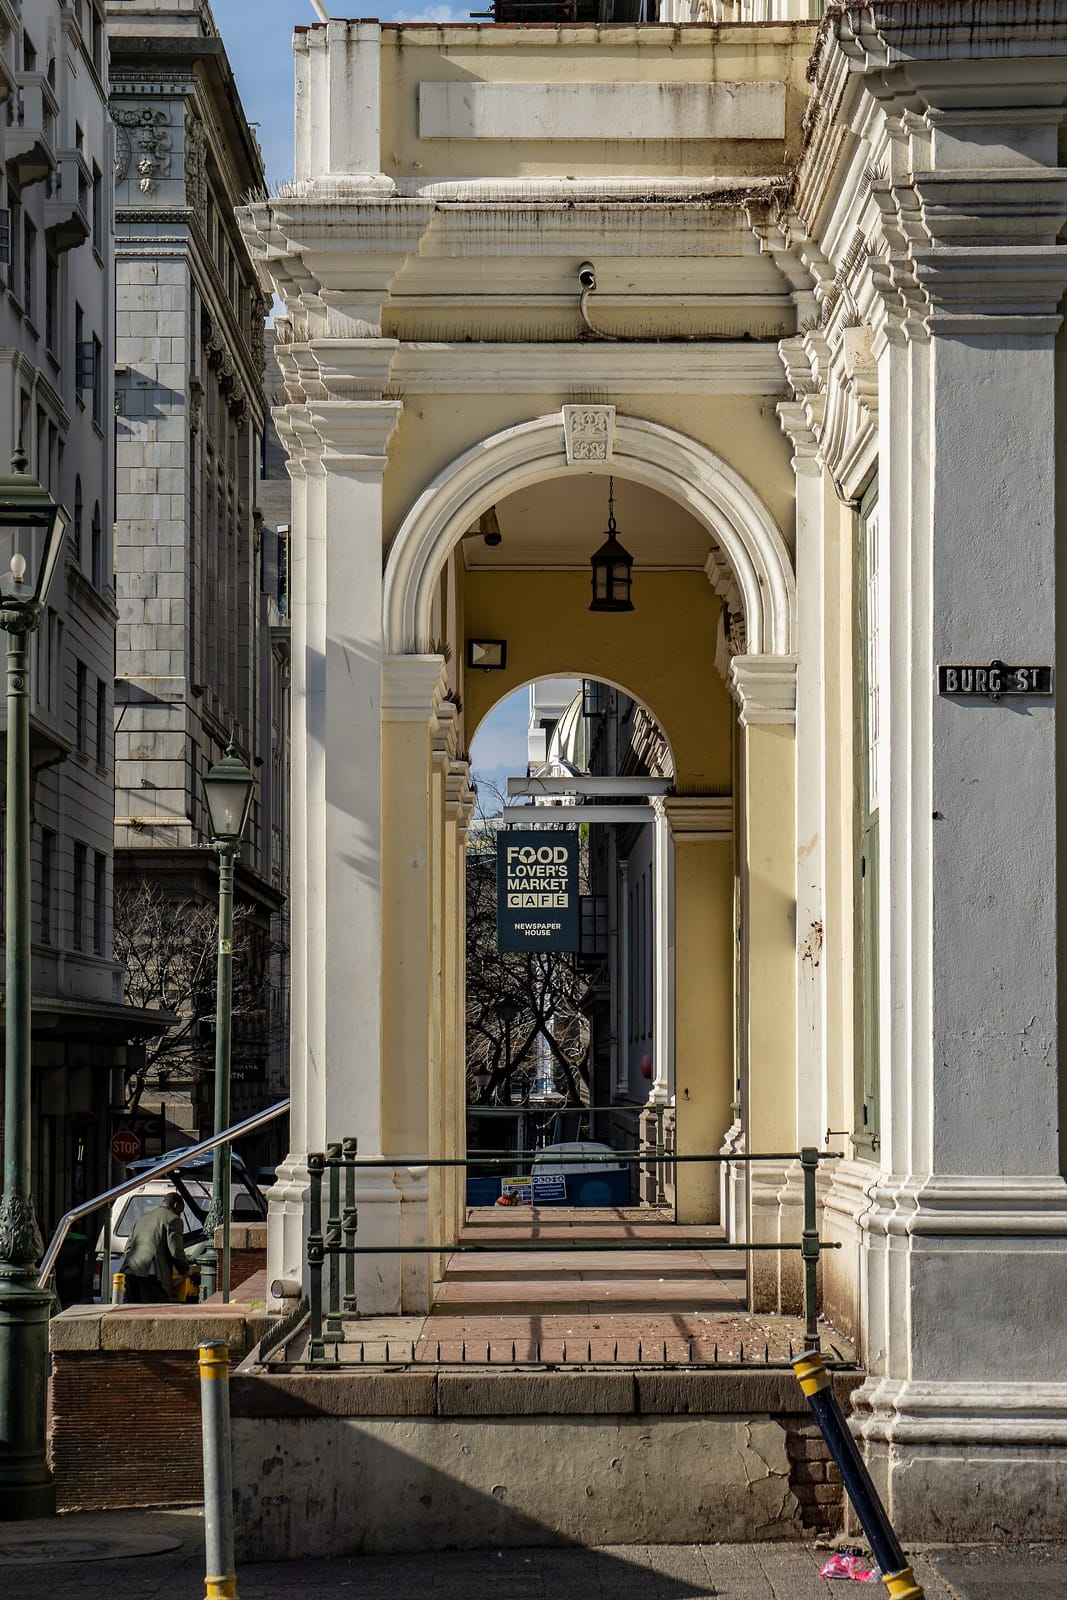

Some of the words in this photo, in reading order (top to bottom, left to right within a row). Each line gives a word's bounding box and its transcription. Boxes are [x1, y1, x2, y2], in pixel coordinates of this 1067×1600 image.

[946, 669, 1001, 692] BURG
[1016, 668, 1040, 691] ST
[507, 846, 569, 864] FOOD
[507, 865, 569, 877] LOVER'S
[507, 879, 569, 890] MARKET
[509, 891, 567, 907] CAFÉ
[119, 1119, 158, 1133] KFC
[112, 1141, 139, 1154] STOP
